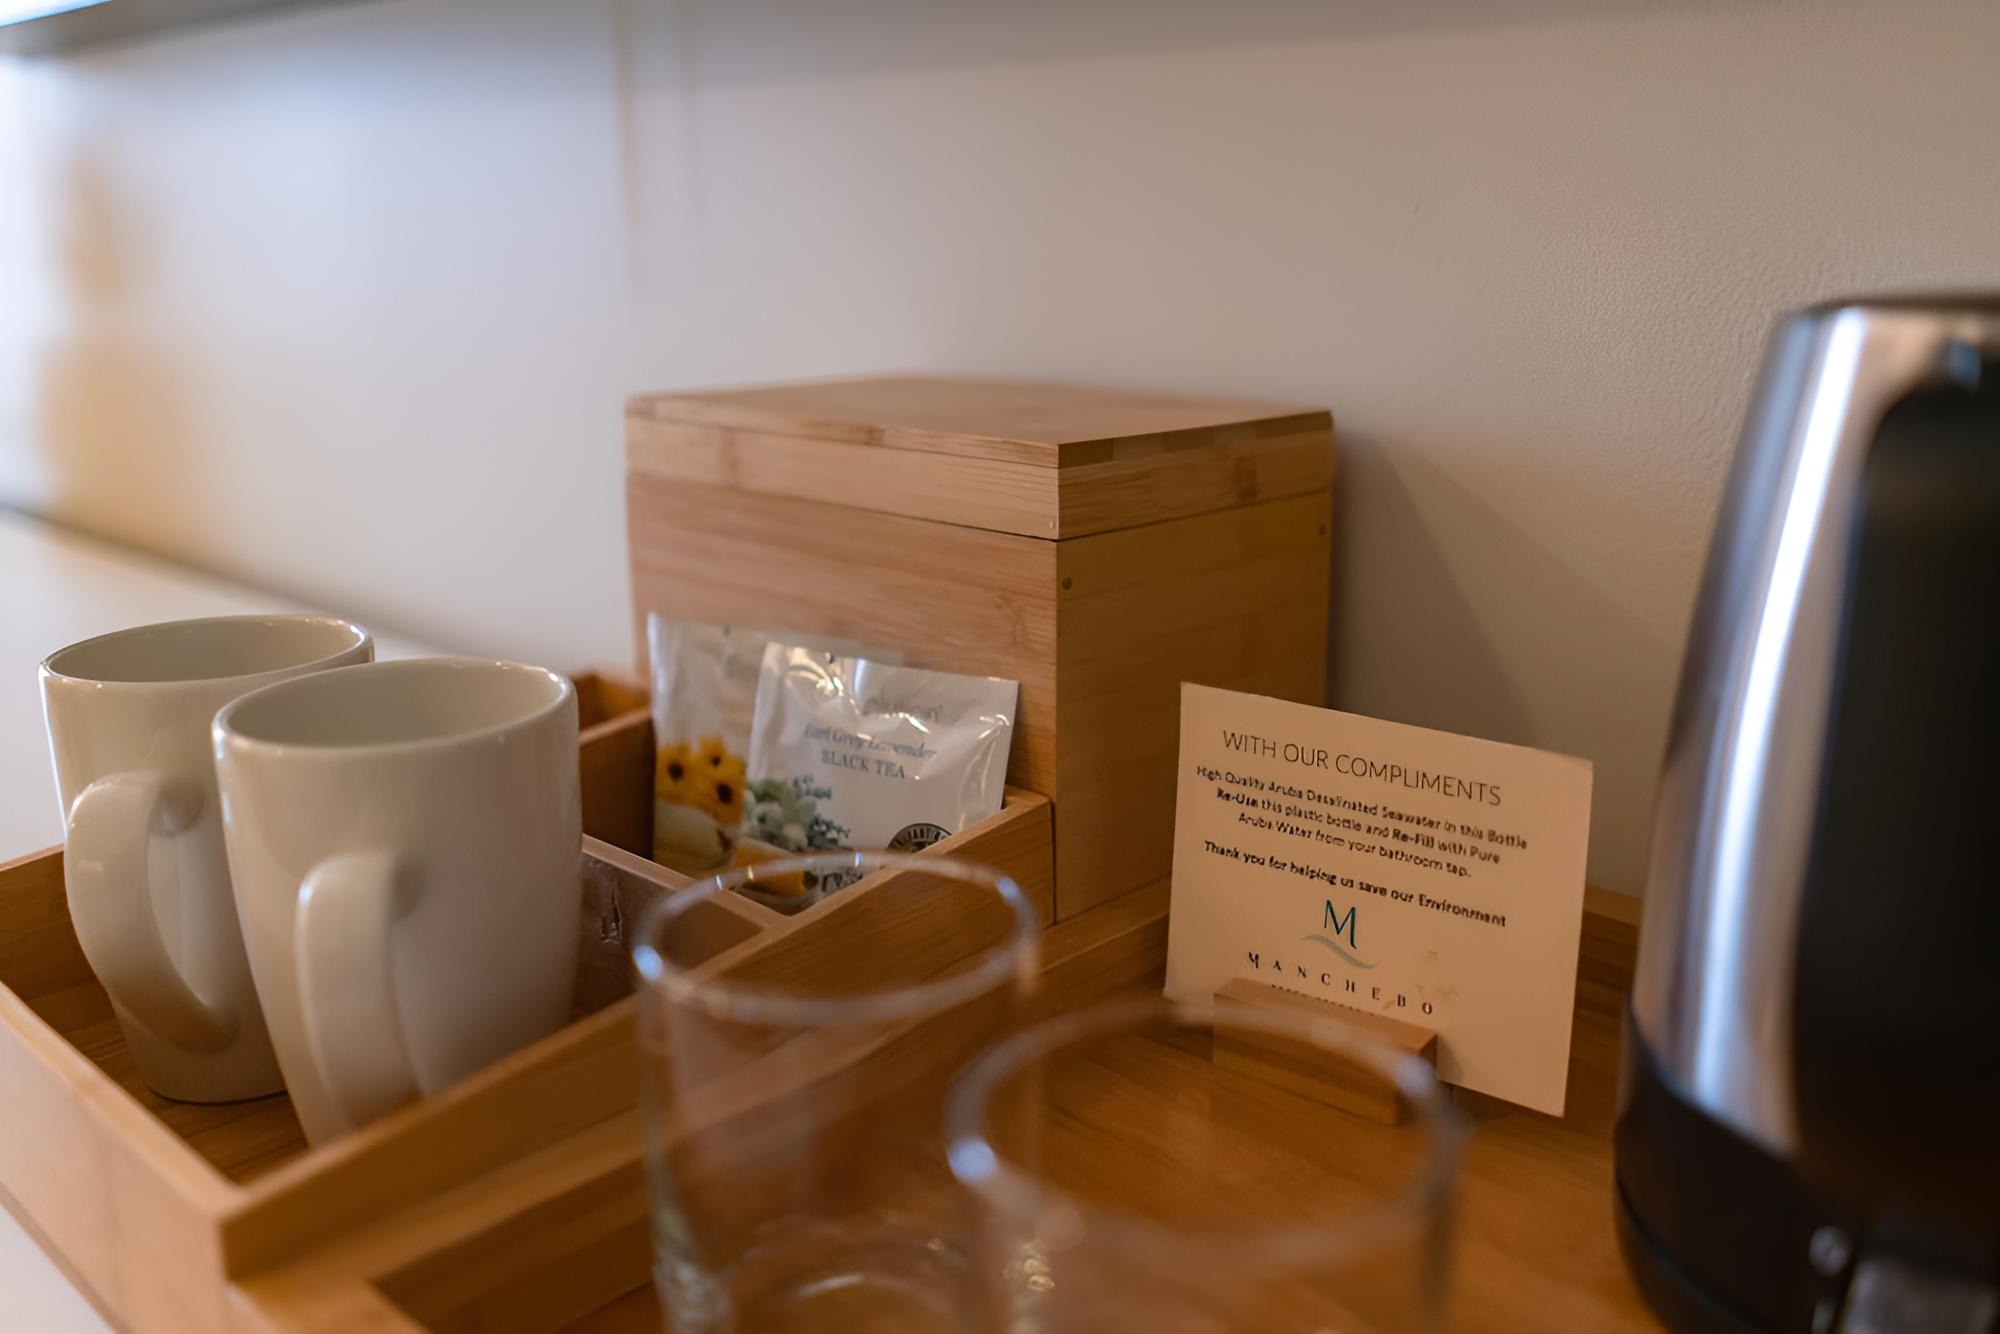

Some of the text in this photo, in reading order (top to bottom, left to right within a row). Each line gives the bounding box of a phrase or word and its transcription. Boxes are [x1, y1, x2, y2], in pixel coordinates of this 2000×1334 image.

[822, 750, 905, 779] BLACK TEA
[1223, 730, 1502, 806] WITH OUR COMPLIMENTS
[1196, 765, 1528, 850] High Quality Aruba Desalinated Seawater in this Bottle
[1216, 787, 1500, 864] Re-Use this plastic bottle and Re-Fill with Pure
[1238, 811, 1471, 878] Aruba Water from your bathroom tap.
[1204, 840, 1507, 927] Thank you for helping us save our Environment
[1324, 899, 1357, 950] M
[1248, 951, 1433, 1015] MANCHEBO
